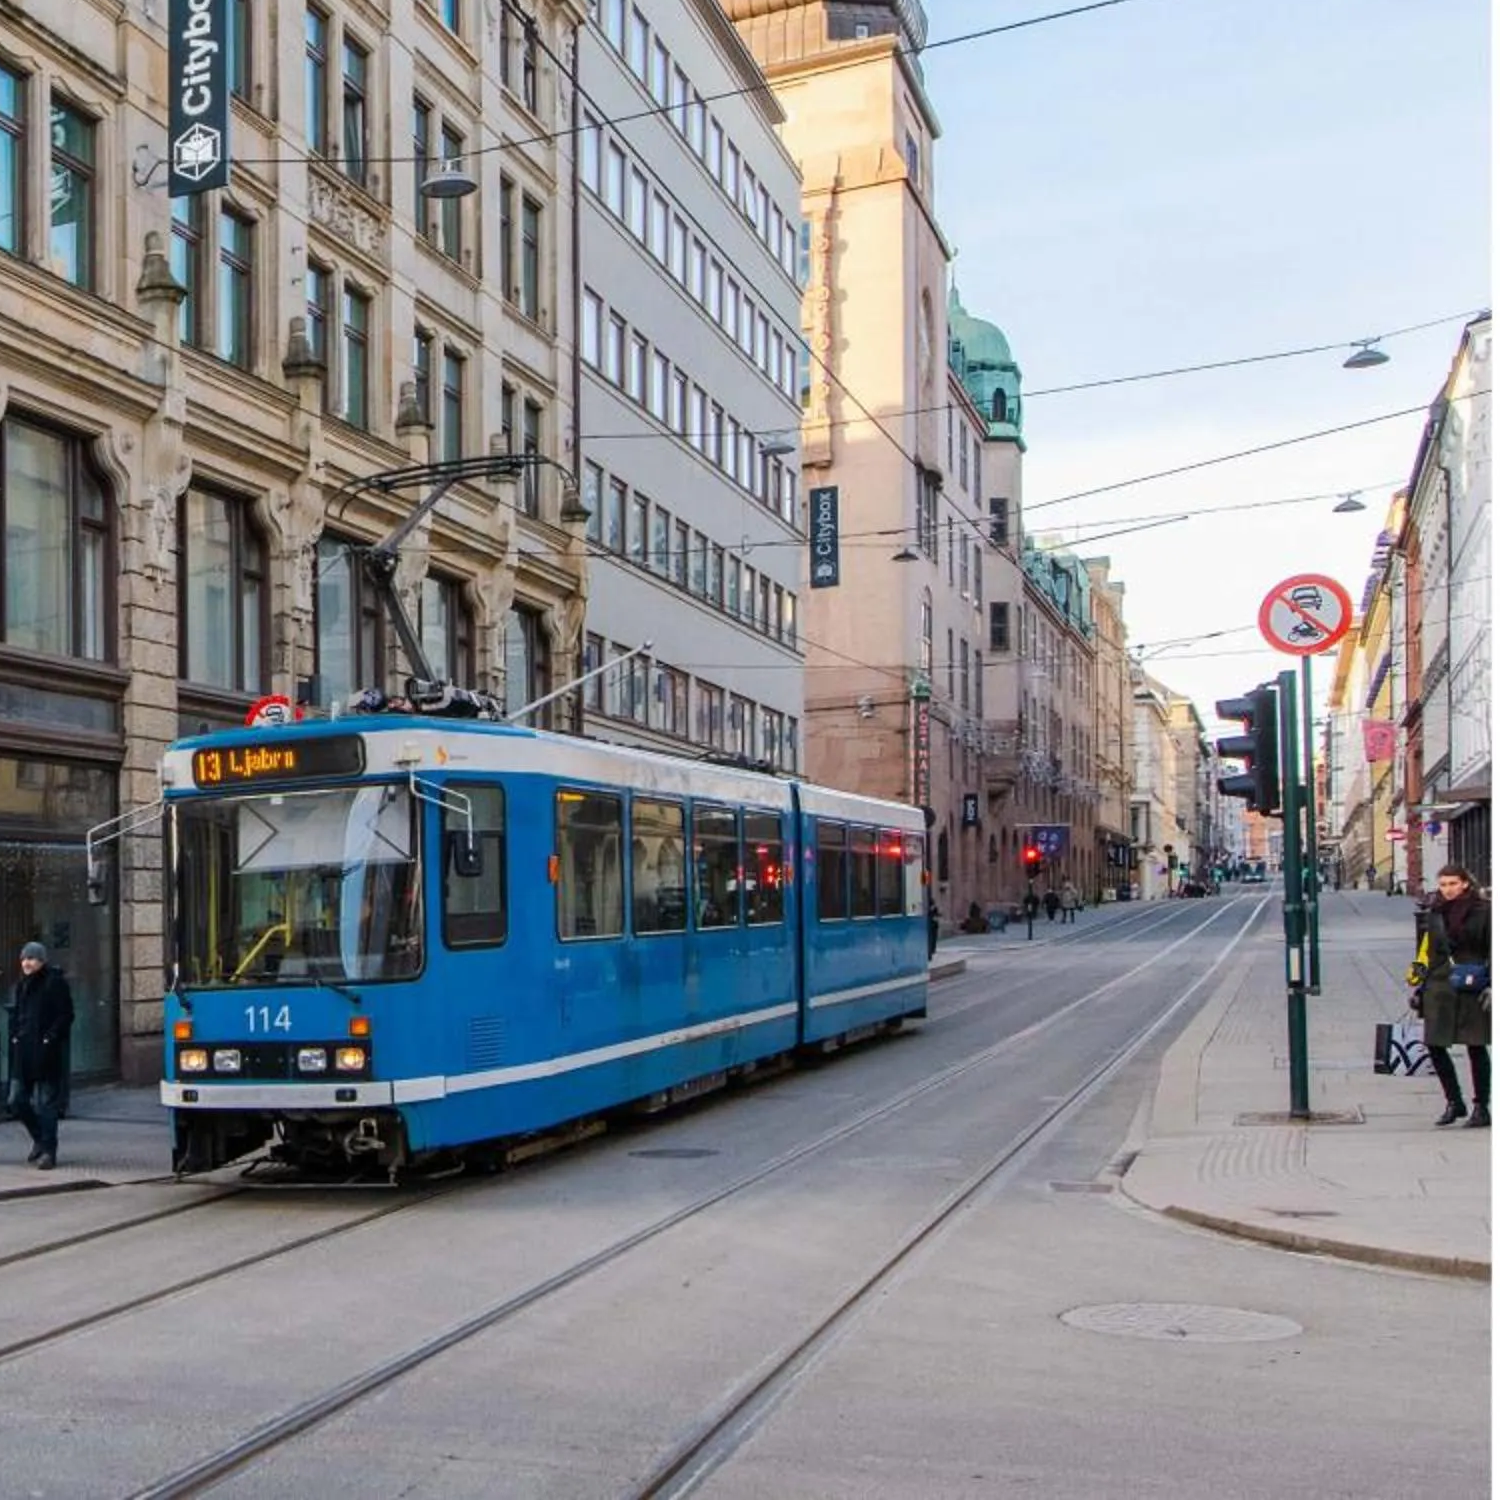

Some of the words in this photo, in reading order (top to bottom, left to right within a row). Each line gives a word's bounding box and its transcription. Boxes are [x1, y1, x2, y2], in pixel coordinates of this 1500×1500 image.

[816, 491, 835, 555] Citybox
[198, 751, 221, 781] 13
[244, 1005, 292, 1033] 114
